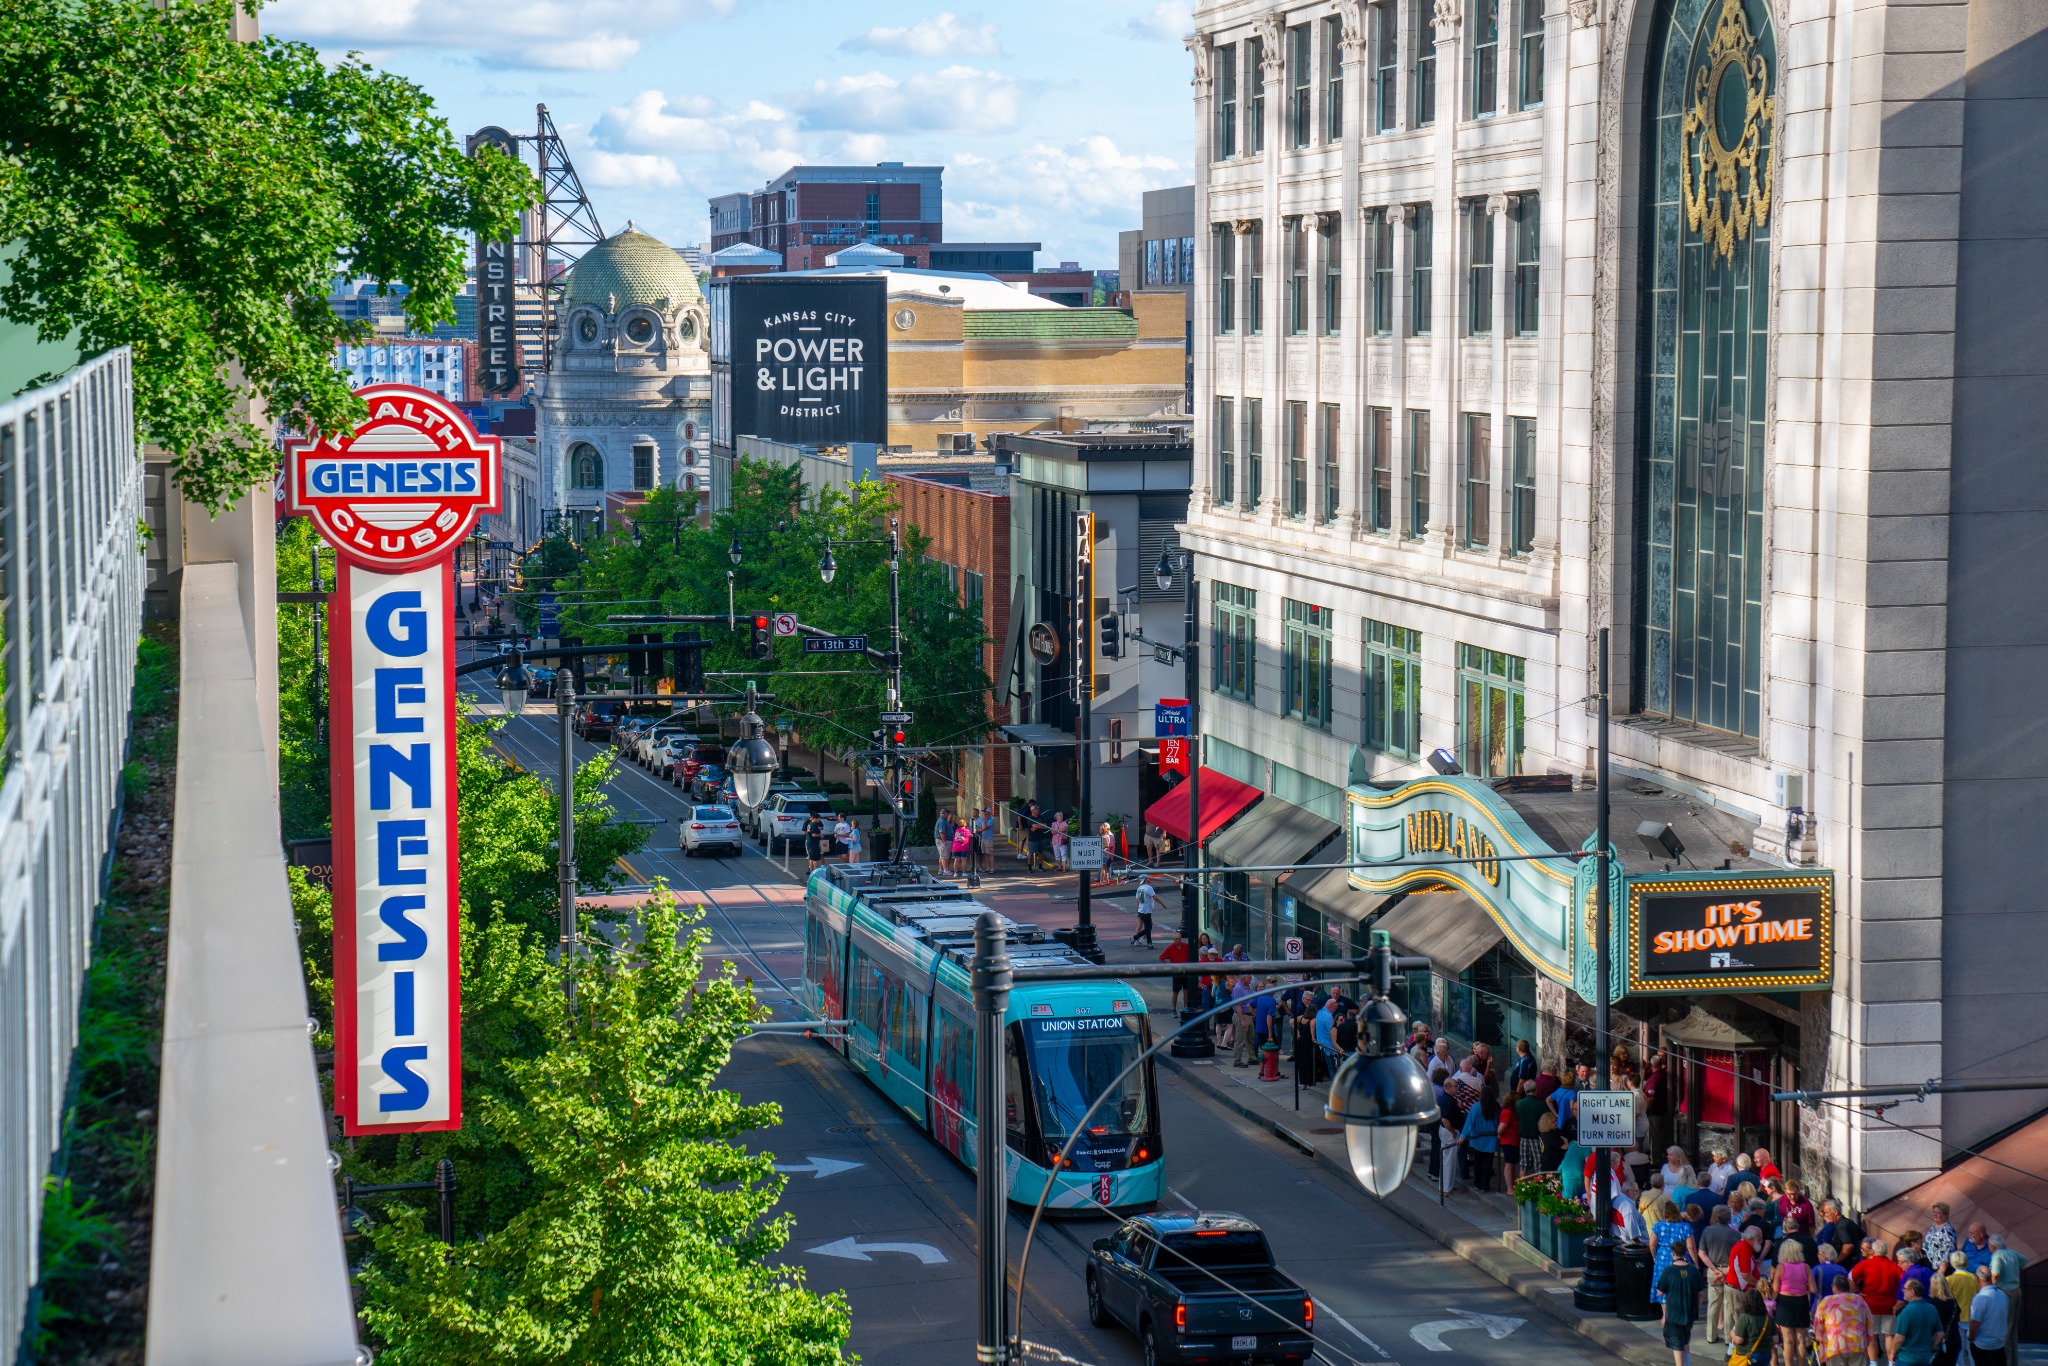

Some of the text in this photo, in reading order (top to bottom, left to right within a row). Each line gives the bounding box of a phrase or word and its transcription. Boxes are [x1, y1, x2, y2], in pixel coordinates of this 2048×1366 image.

[763, 310, 856, 328] KANSAS CITY
[756, 338, 864, 362] POWER
[757, 367, 864, 391] & LIGHT
[780, 404, 841, 418] DISTRICT
[311, 461, 477, 493] GENESIS
[331, 507, 460, 552] CLUBS
[823, 639, 860, 649] 13th St
[1158, 715, 1186, 724] ULTRA
[1166, 746, 1180, 758] 27
[365, 590, 431, 1112] GENESIS
[1077, 849, 1096, 857] MUST
[1407, 809, 1499, 887] MIDLAND
[1705, 900, 1762, 927] IT'S
[1653, 917, 1814, 954] SHOWTIME
[1041, 1017, 1122, 1031] UNION STATION
[1582, 1098, 1631, 1108] RIGHT LANE
[1591, 1113, 1622, 1125] MUST
[1581, 1130, 1632, 1140] TURN RIGHT
